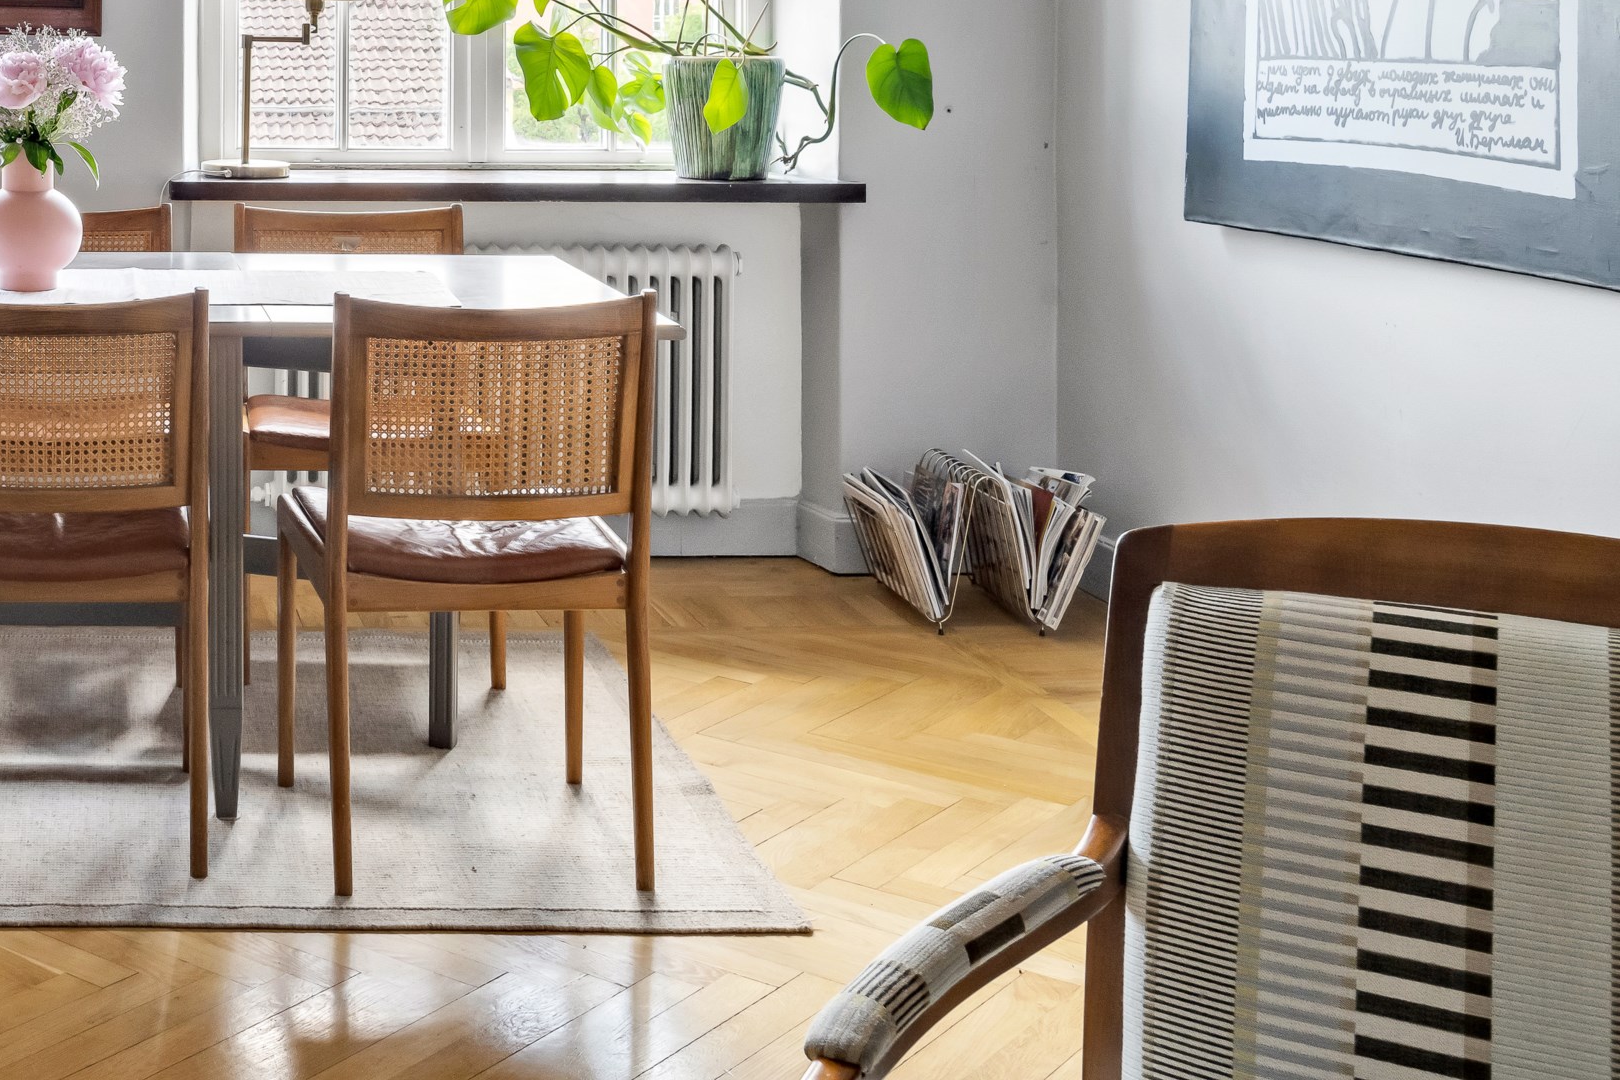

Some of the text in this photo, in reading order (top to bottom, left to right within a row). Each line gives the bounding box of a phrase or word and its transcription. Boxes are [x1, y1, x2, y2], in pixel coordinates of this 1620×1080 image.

[1303, 84, 1321, 94] на
[1531, 96, 1545, 109] и
[1431, 109, 1467, 131] друг
[1469, 110, 1516, 132] друга
